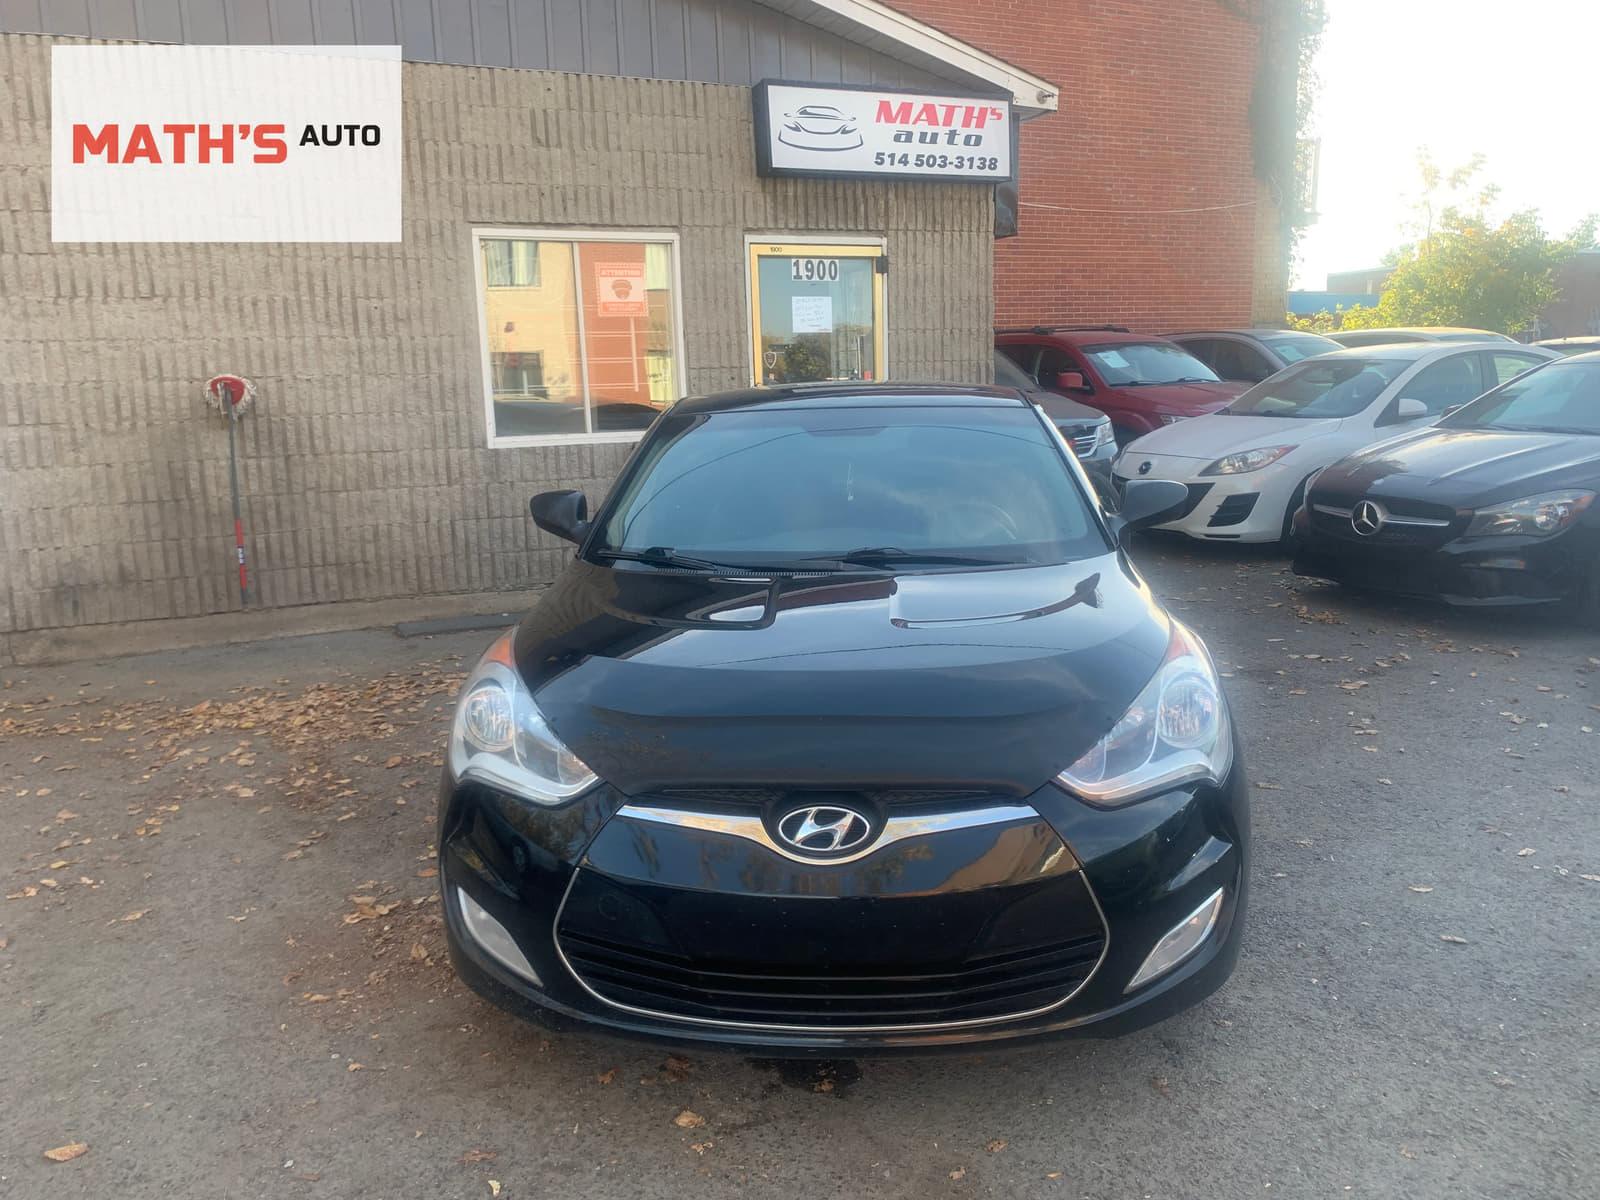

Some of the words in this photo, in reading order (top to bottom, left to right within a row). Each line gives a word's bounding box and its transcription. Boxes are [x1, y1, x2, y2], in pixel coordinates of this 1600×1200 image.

[893, 129, 983, 147] auto
[874, 152, 910, 166] 514
[914, 154, 998, 171] 503-3138
[792, 259, 838, 281] 1900
